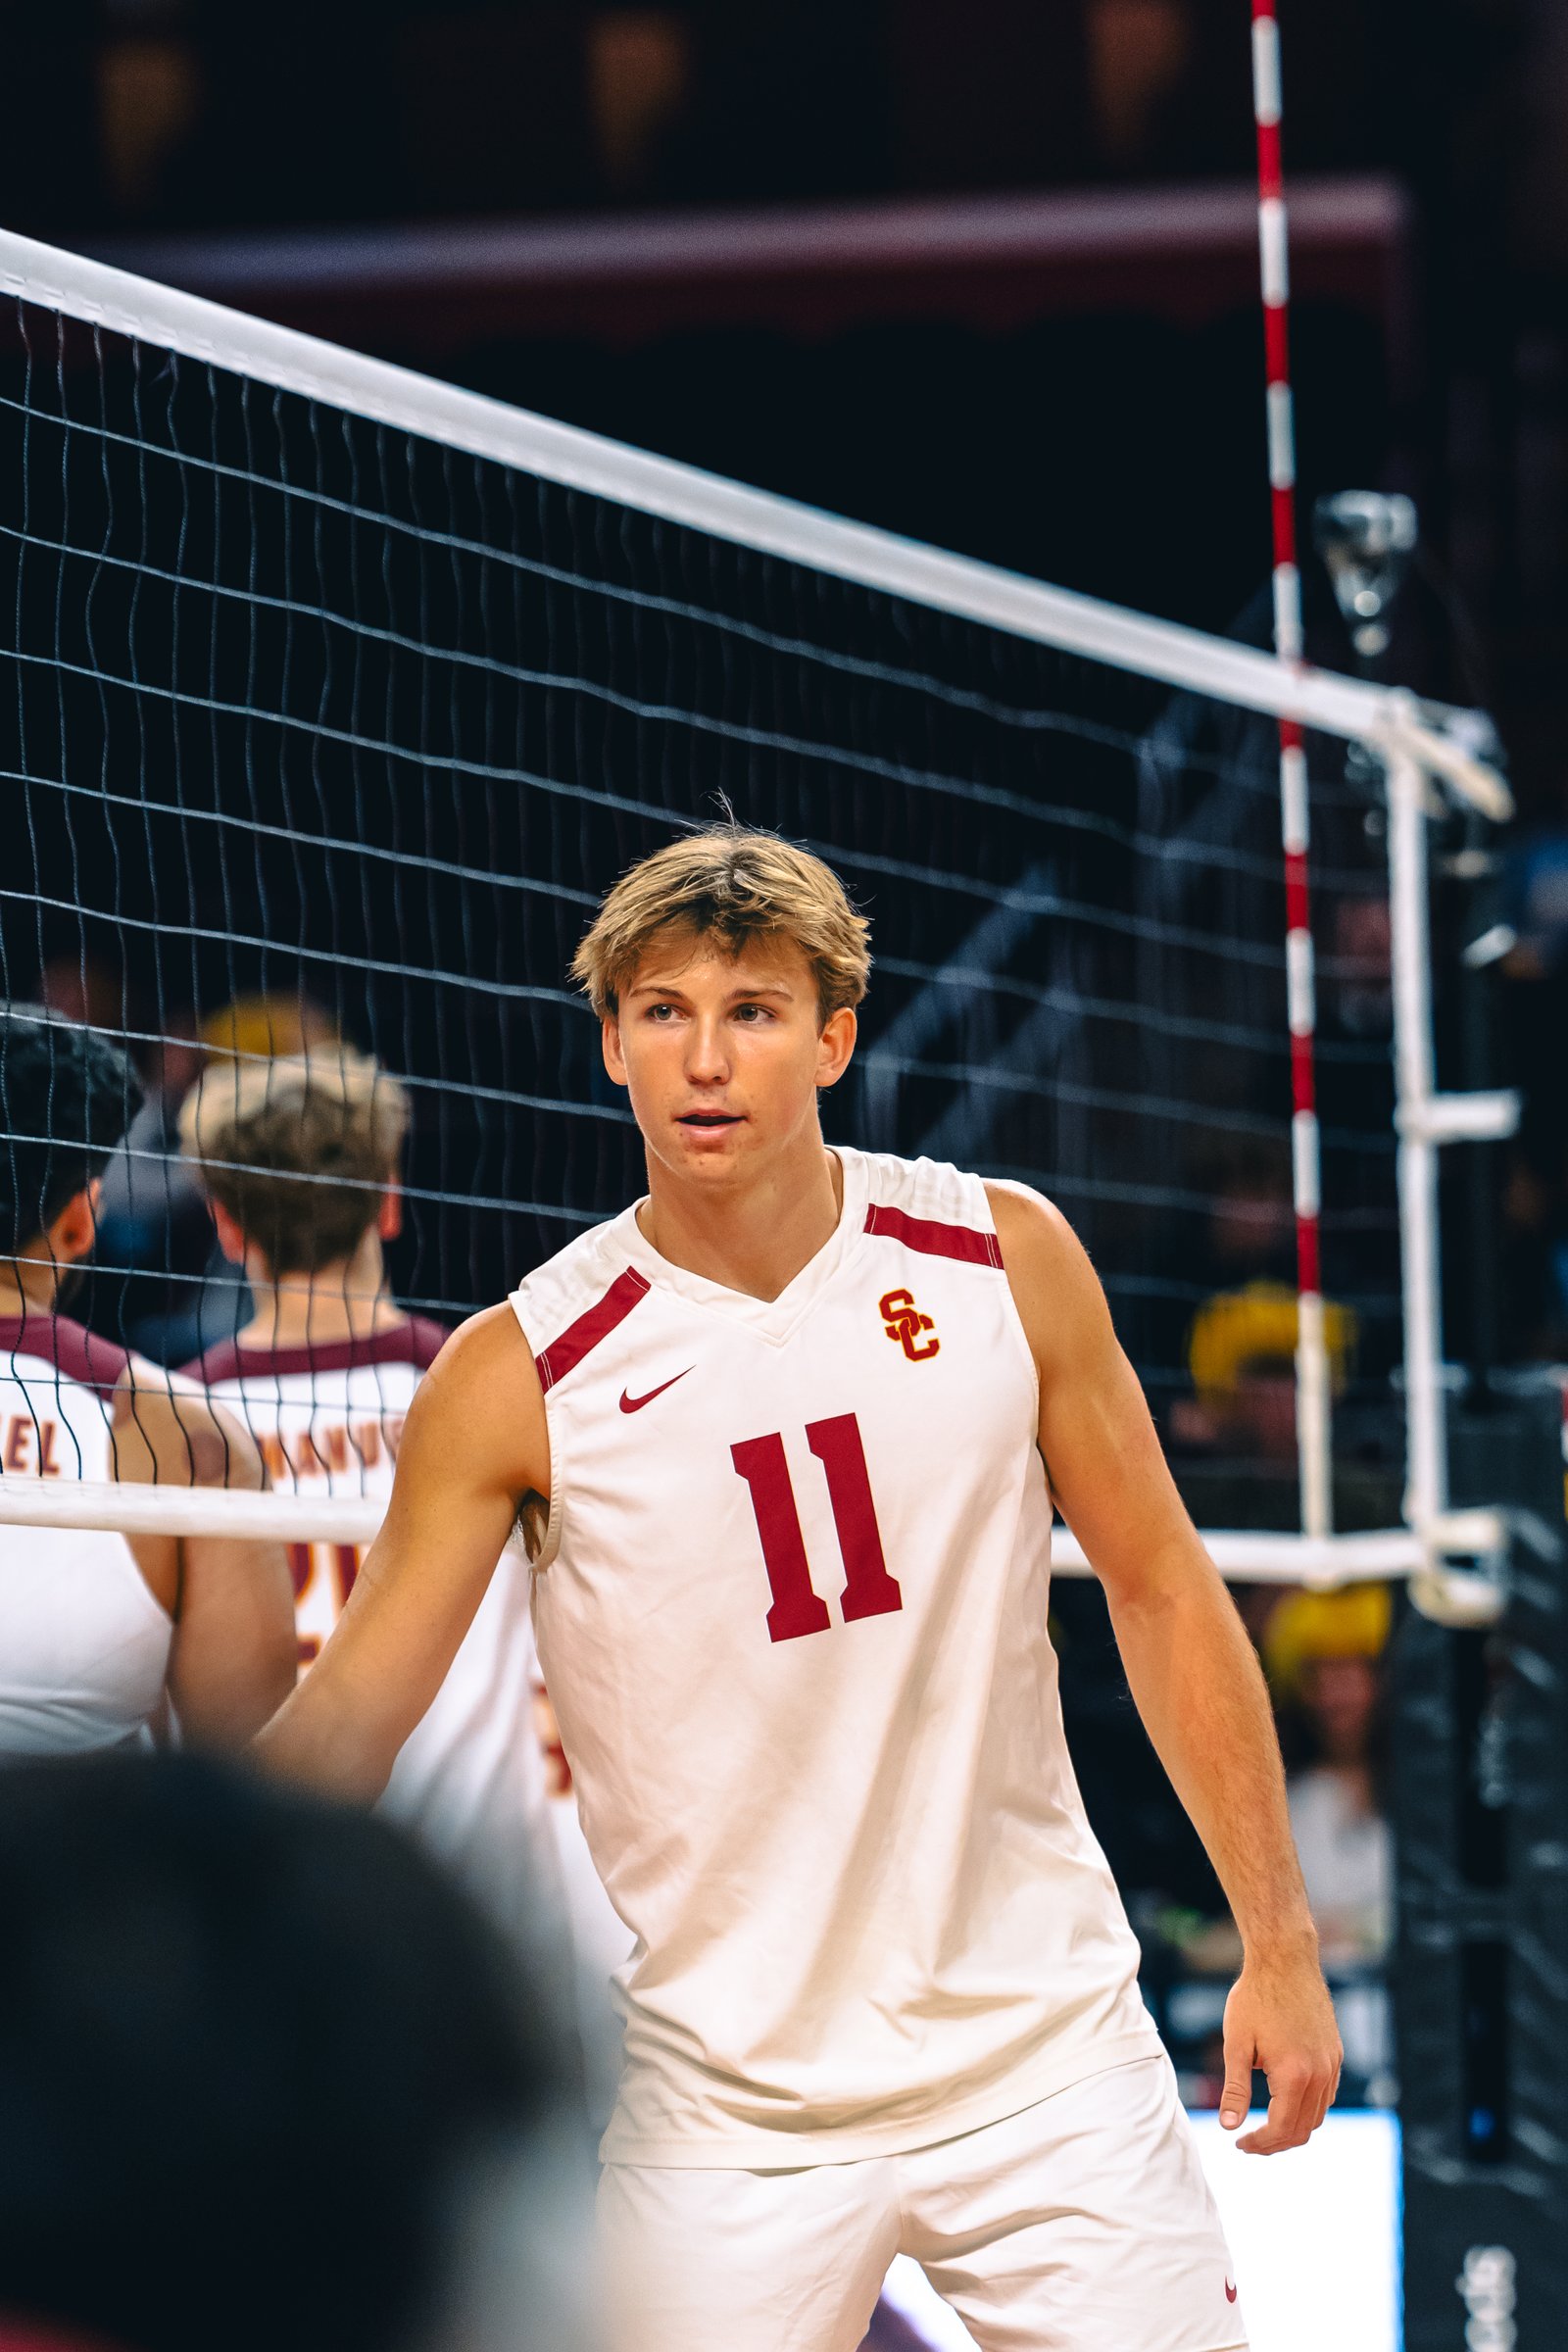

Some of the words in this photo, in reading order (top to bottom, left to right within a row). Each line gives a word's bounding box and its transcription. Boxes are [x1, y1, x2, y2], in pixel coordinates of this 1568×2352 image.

[878, 1287, 941, 1362] SC
[0, 1414, 61, 1477] EL
[729, 1411, 904, 1643] 11
